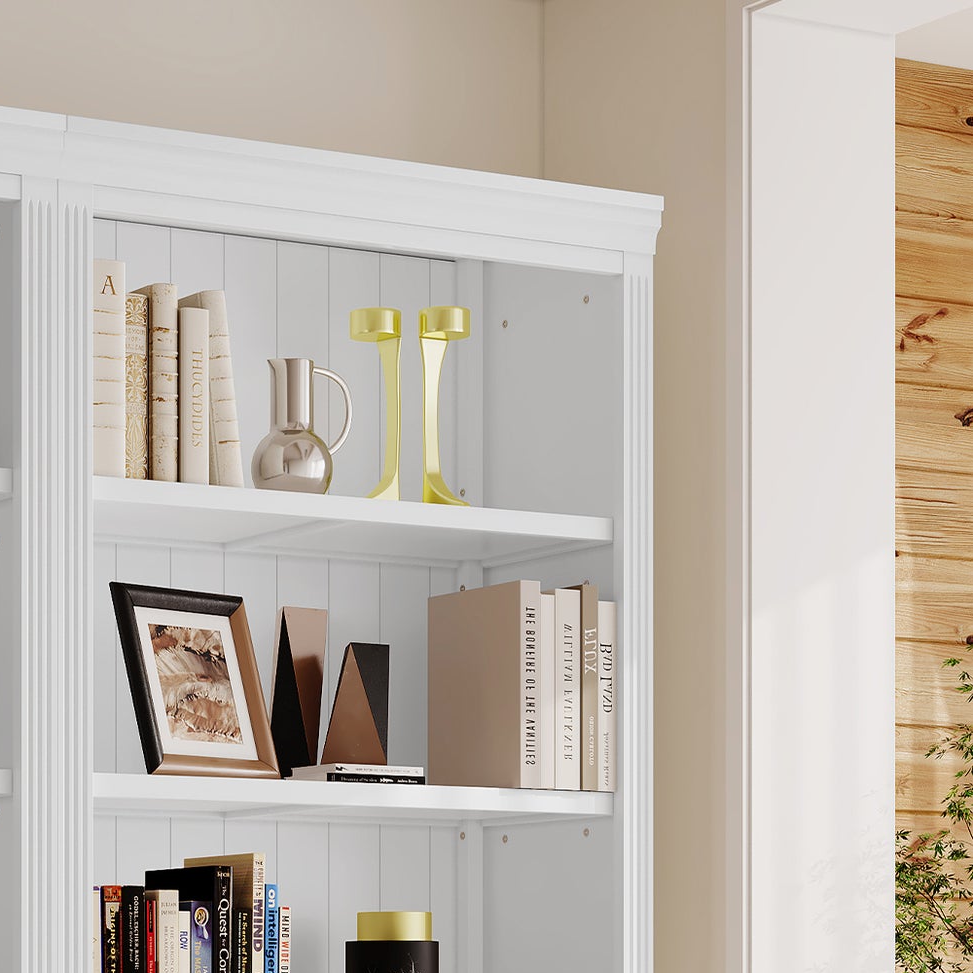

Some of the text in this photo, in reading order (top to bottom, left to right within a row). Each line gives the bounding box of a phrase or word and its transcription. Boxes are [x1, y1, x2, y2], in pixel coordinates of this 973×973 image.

[100, 275, 118, 296] A
[191, 349, 204, 449] THUCYDIDES
[268, 888, 276, 908] on
[218, 898, 230, 938] Quest
[252, 898, 264, 952] MIND
[282, 916, 290, 938] MIND
[180, 930, 188, 950] FLOW
[242, 946, 248, 956] of
[281, 942, 289, 962] WIDE
